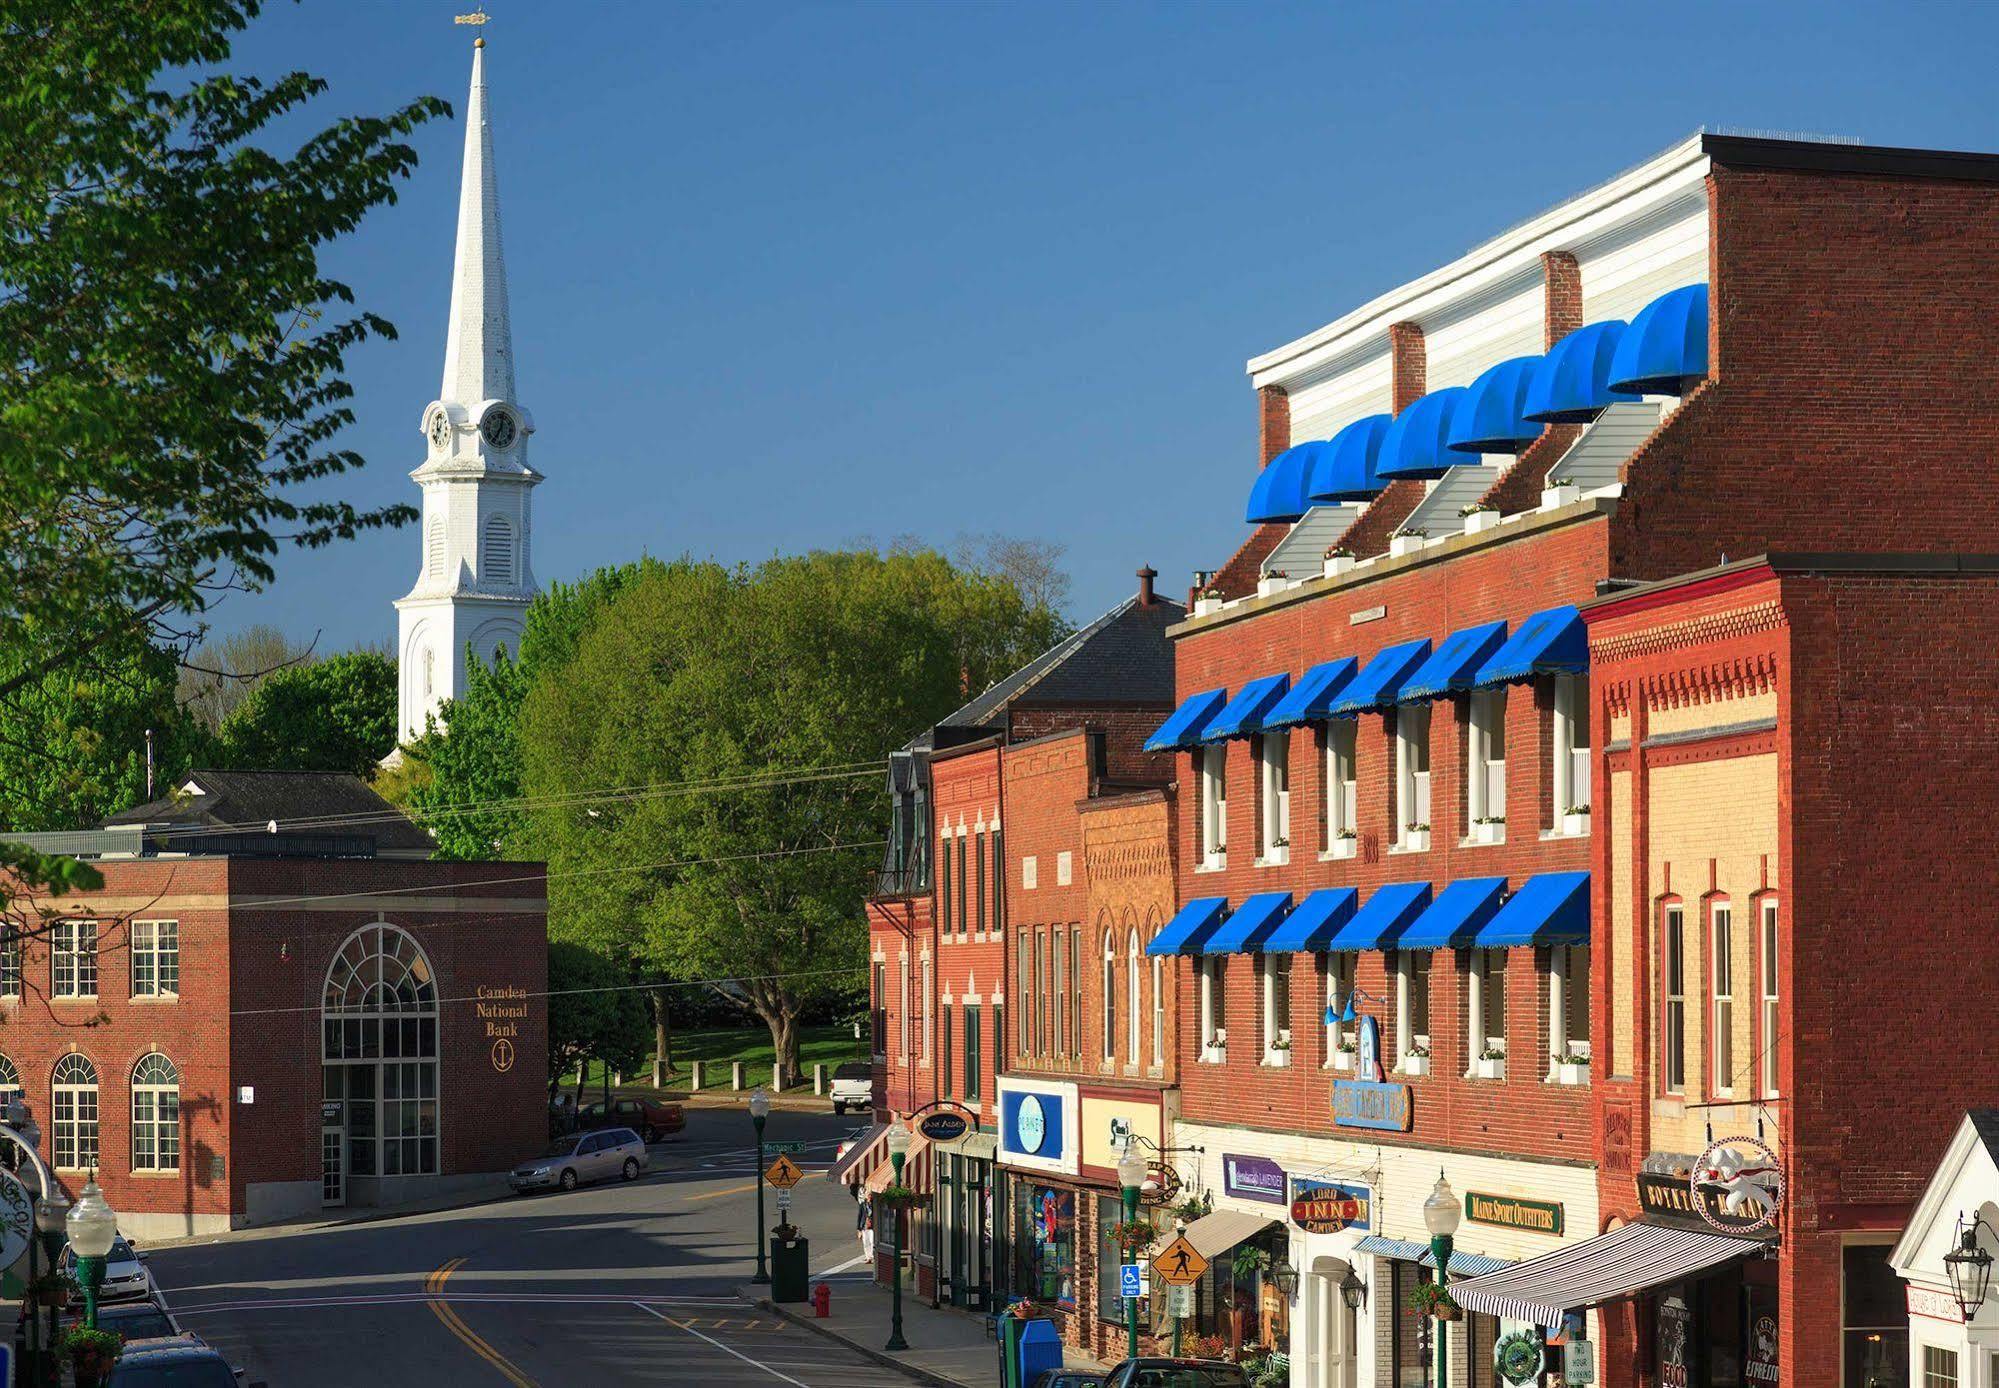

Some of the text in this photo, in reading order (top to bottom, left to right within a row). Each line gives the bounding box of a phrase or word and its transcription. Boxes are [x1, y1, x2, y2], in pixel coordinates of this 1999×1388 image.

[477, 984, 526, 999] Camden
[476, 1003, 528, 1018] National
[485, 1021, 518, 1036] Bank
[1312, 1187, 1337, 1201] LORD
[1304, 1201, 1345, 1219] INN
[1472, 1196, 1554, 1229] MAINE SPORT OUTFITTERS
[1305, 1218, 1345, 1234] CAMDEN
[1574, 1343, 1586, 1355] TWO
[1572, 1357, 1588, 1368] HOUR
[1568, 1369, 1592, 1379] PARKING
[1662, 1361, 1687, 1388] FOOD
